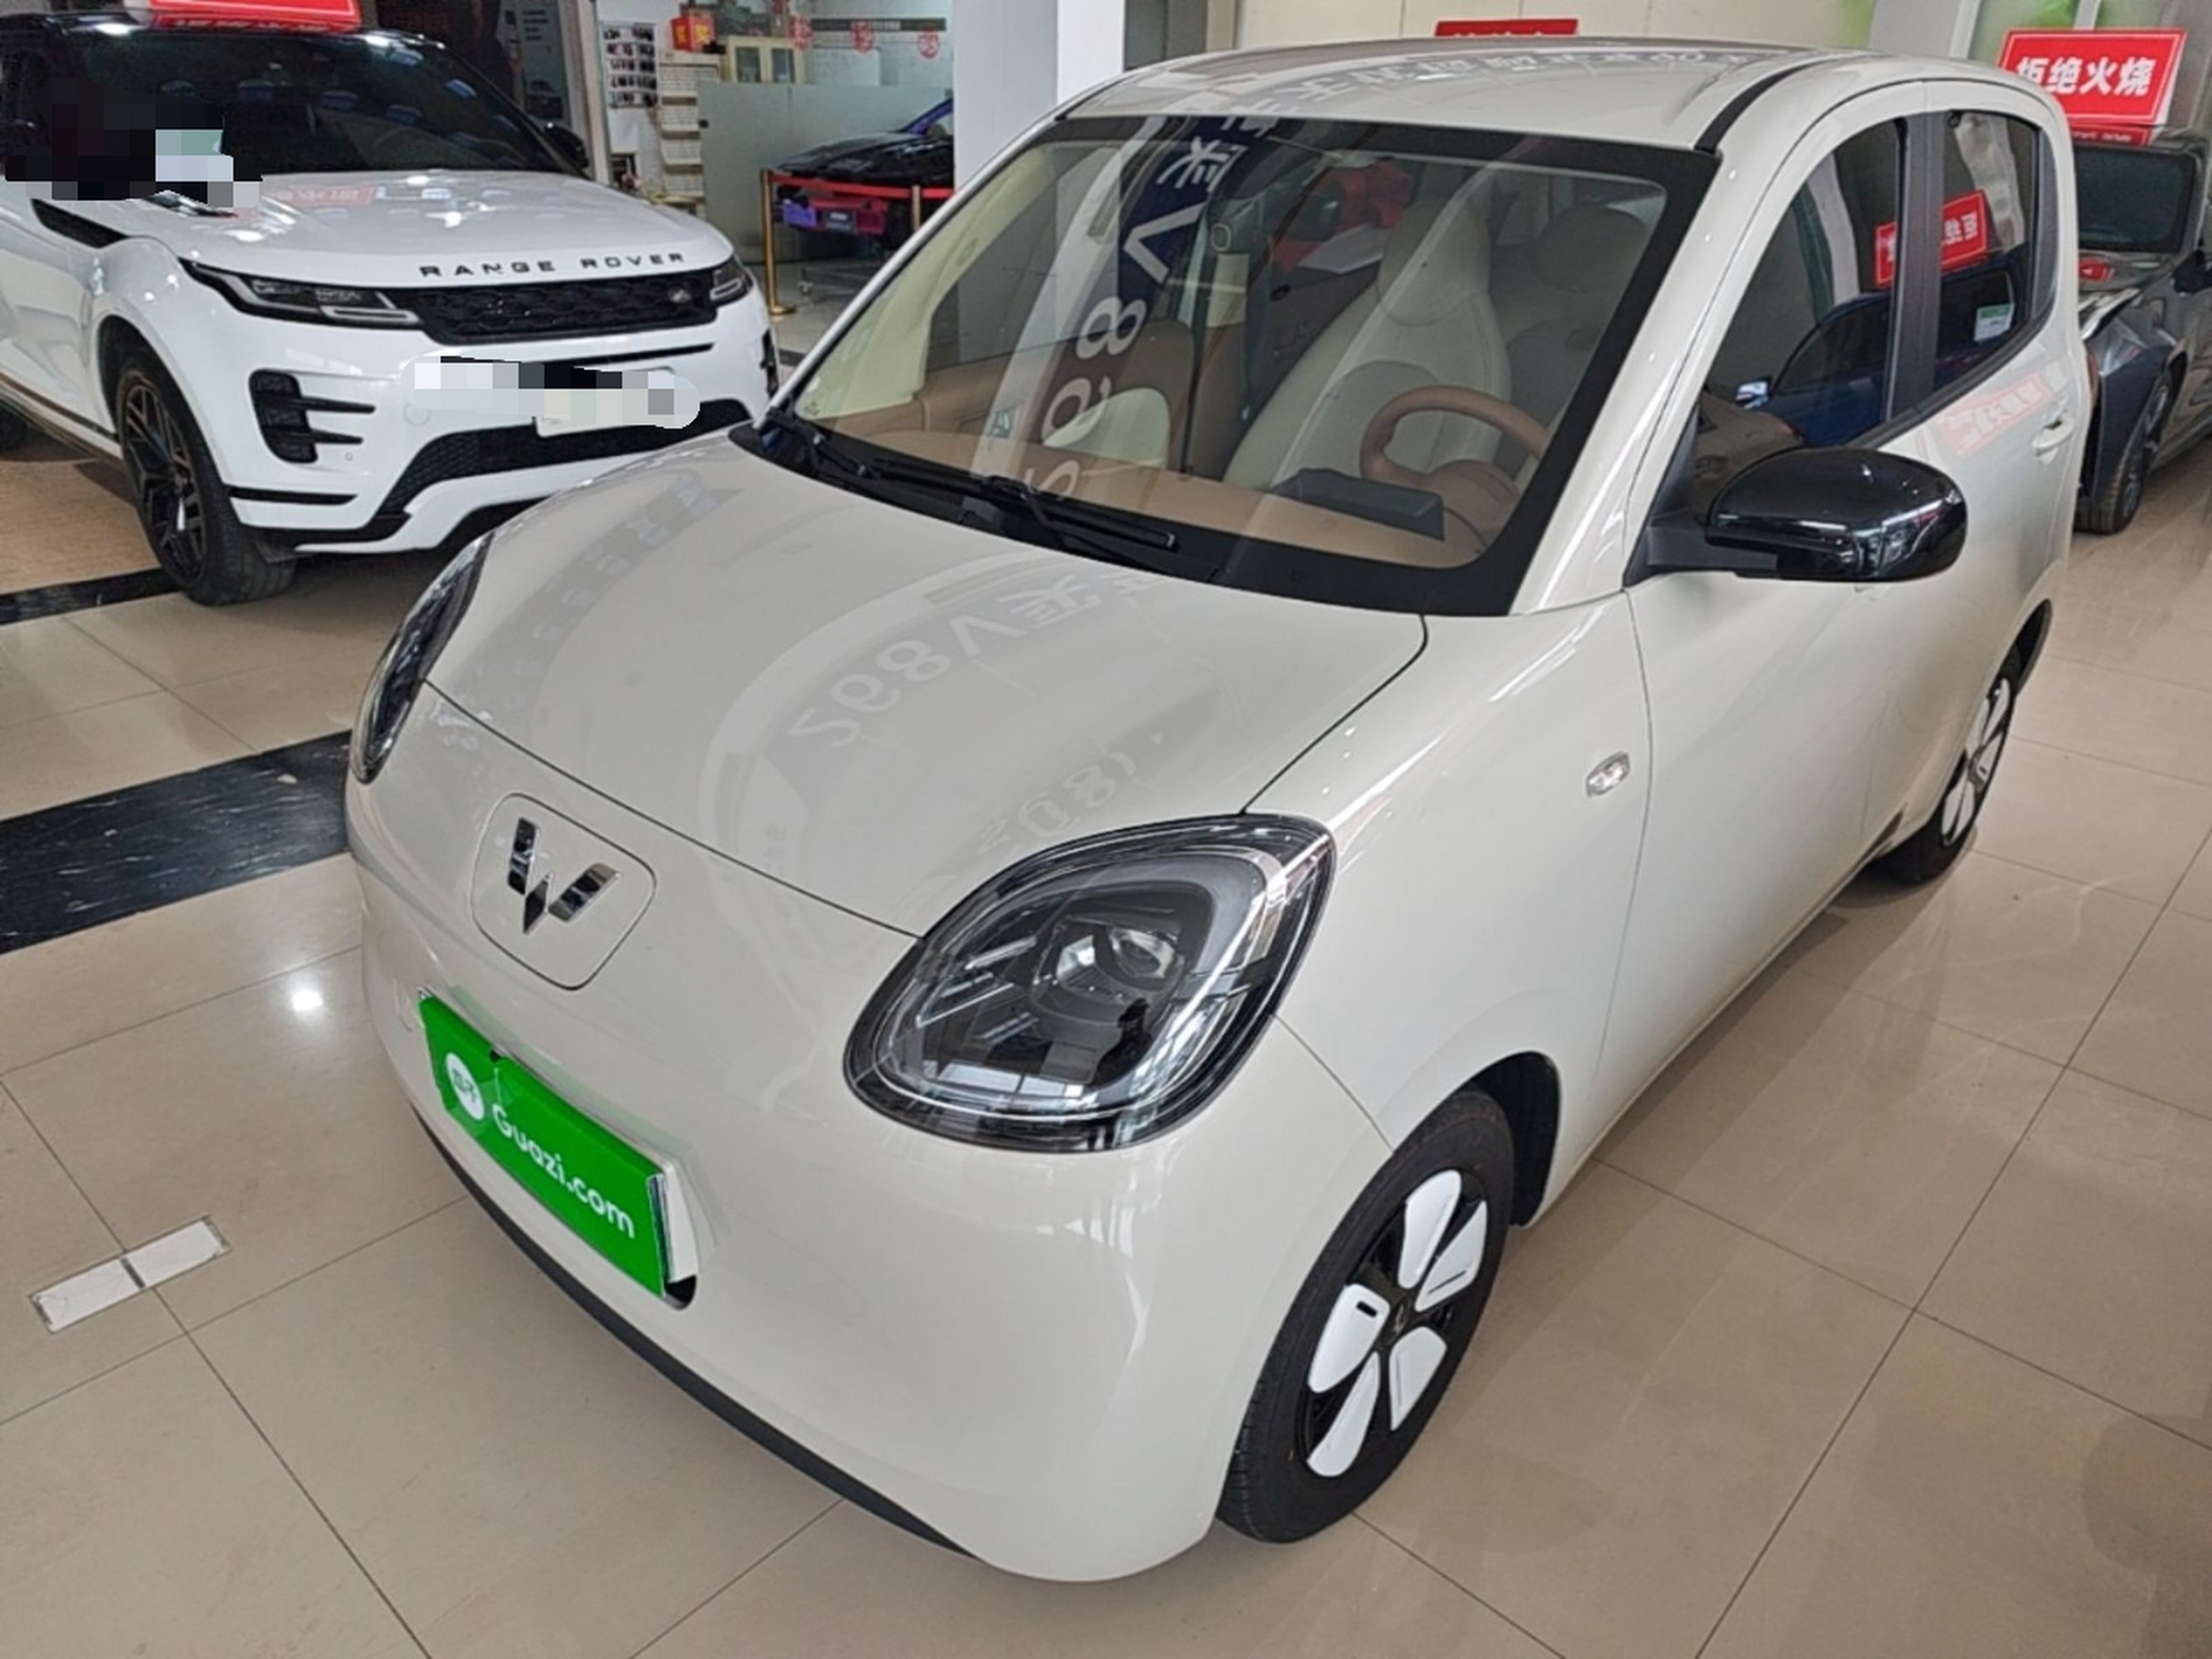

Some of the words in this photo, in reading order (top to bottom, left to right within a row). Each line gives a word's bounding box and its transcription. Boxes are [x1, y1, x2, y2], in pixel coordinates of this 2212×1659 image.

[419, 260, 556, 278] RANGE
[579, 252, 684, 270] ROVER
[492, 1103, 635, 1239] Guazi.com
